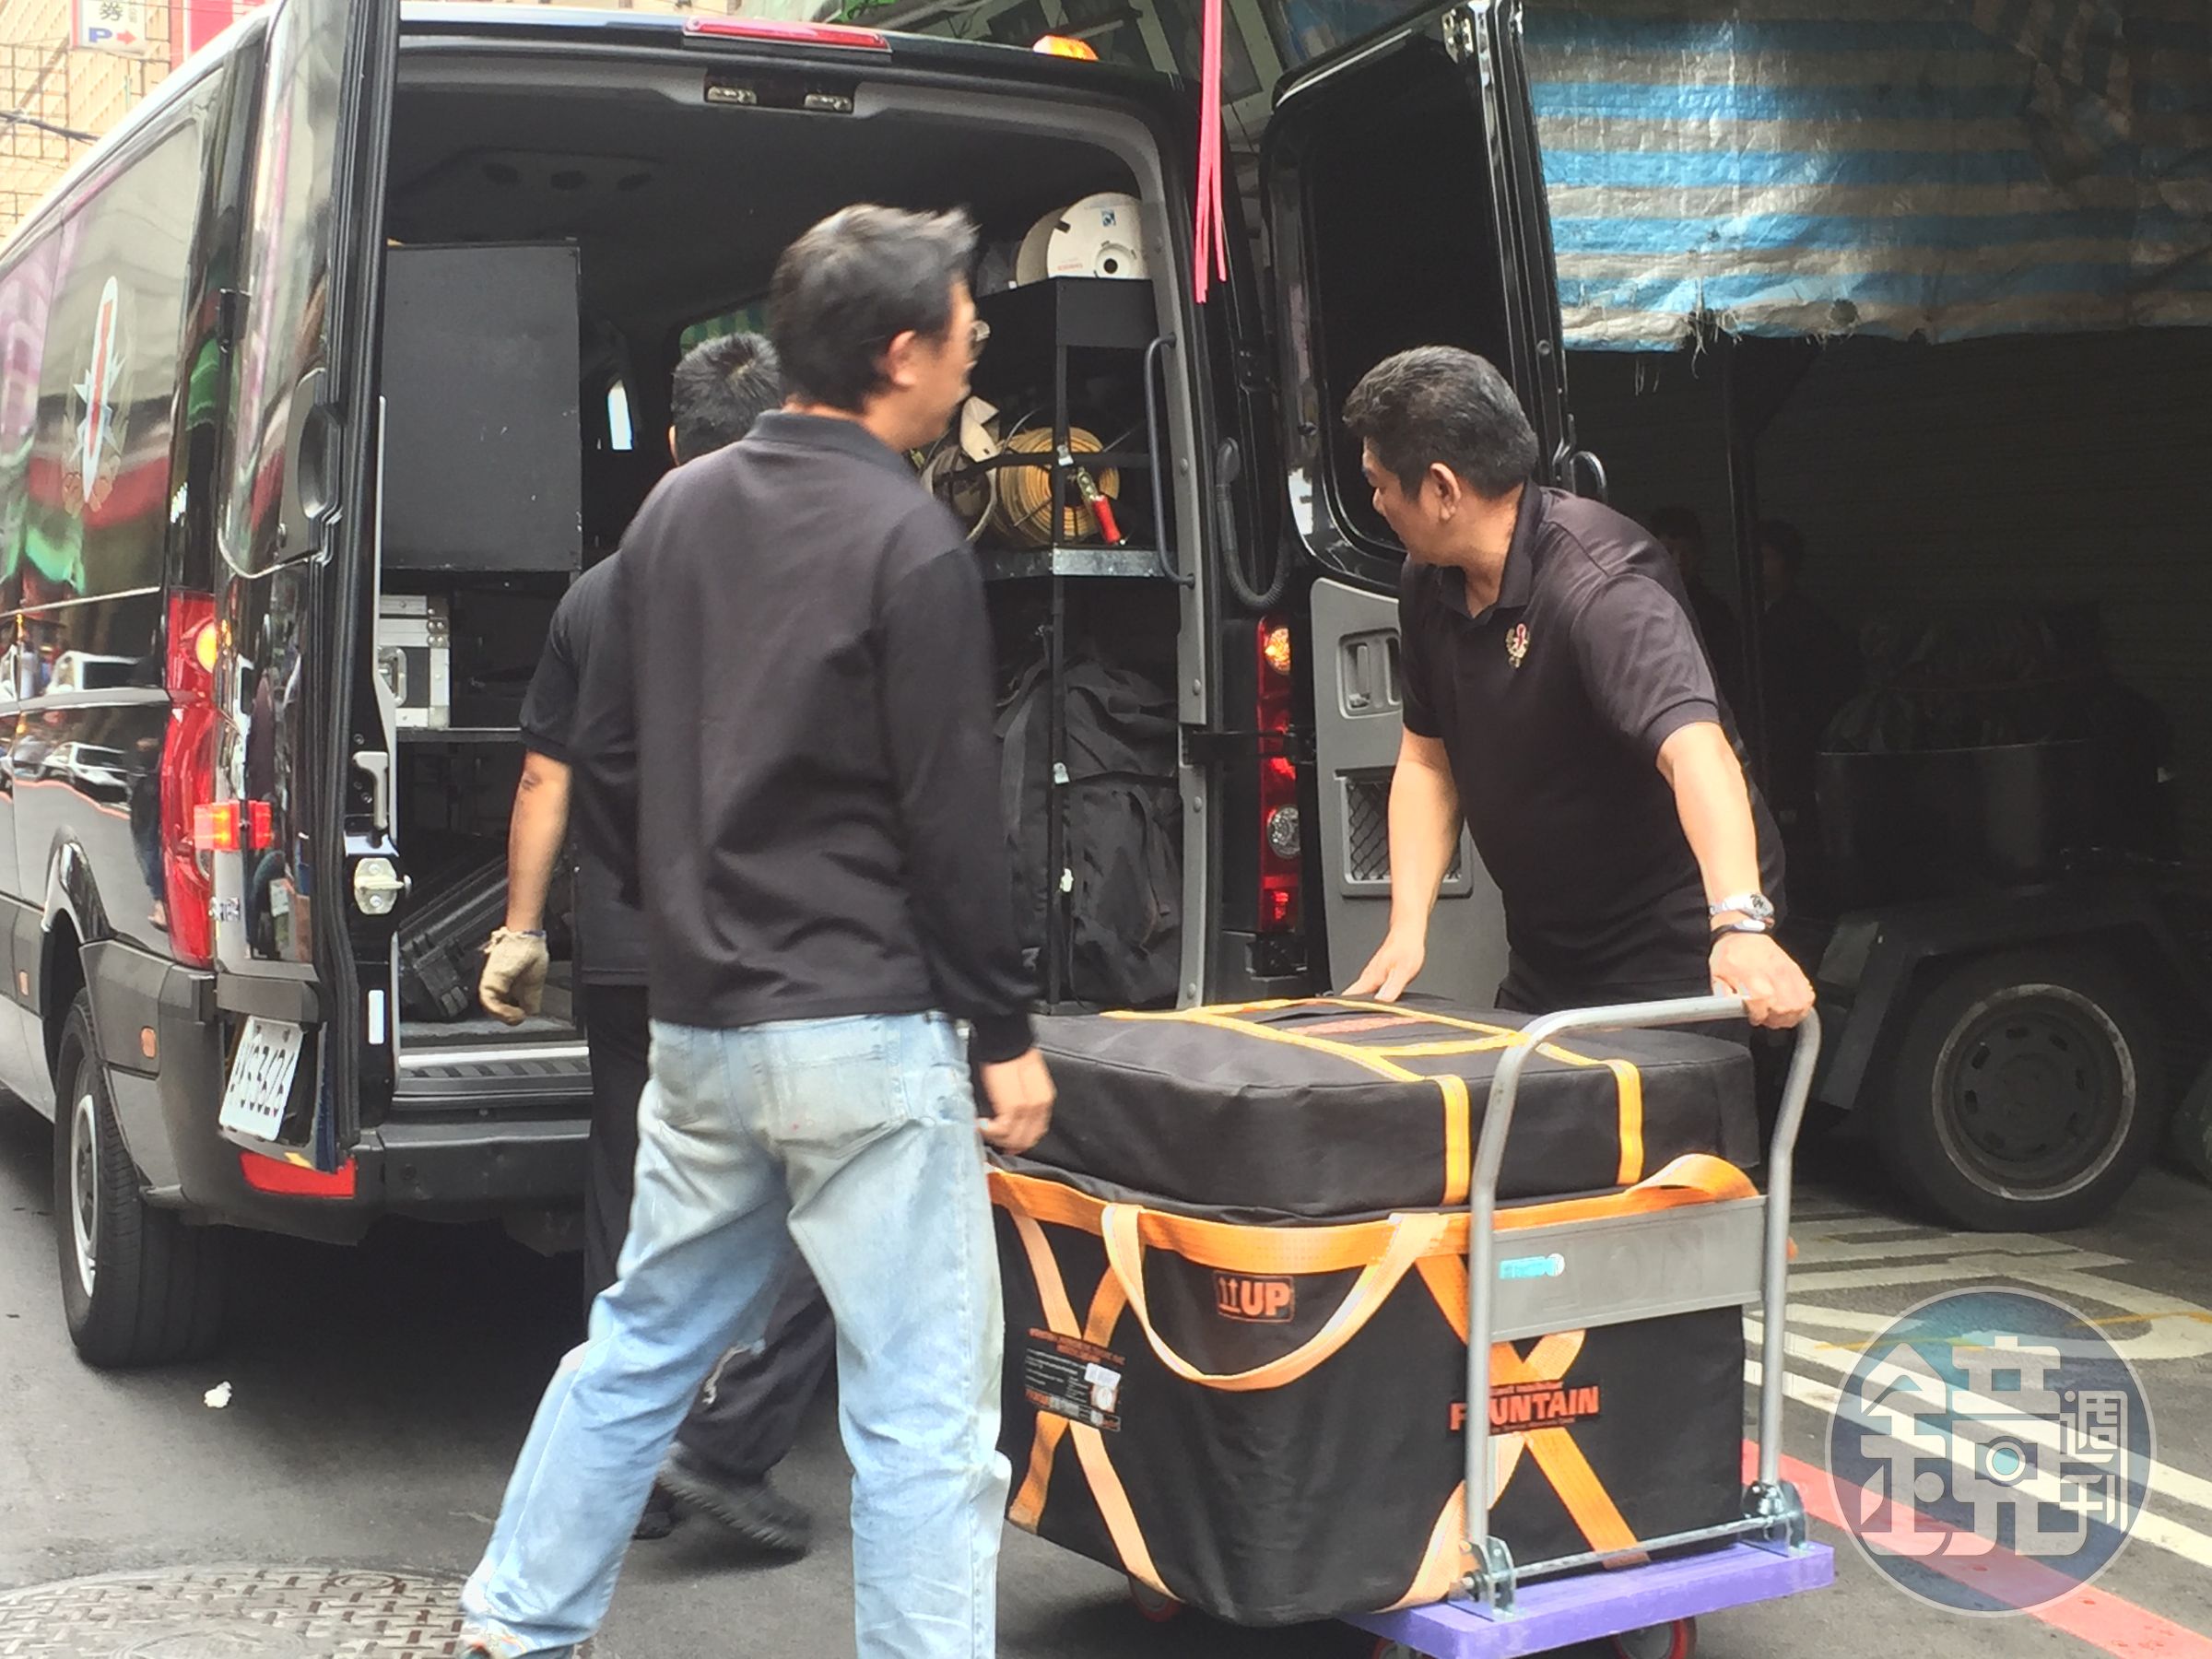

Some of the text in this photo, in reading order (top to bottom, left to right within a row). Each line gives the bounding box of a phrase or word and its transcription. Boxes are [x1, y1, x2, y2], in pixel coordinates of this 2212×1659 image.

[88, 27, 112, 43] P
[1241, 1280, 1290, 1316] UP
[1450, 1385, 1599, 1430] FUNTAIN
